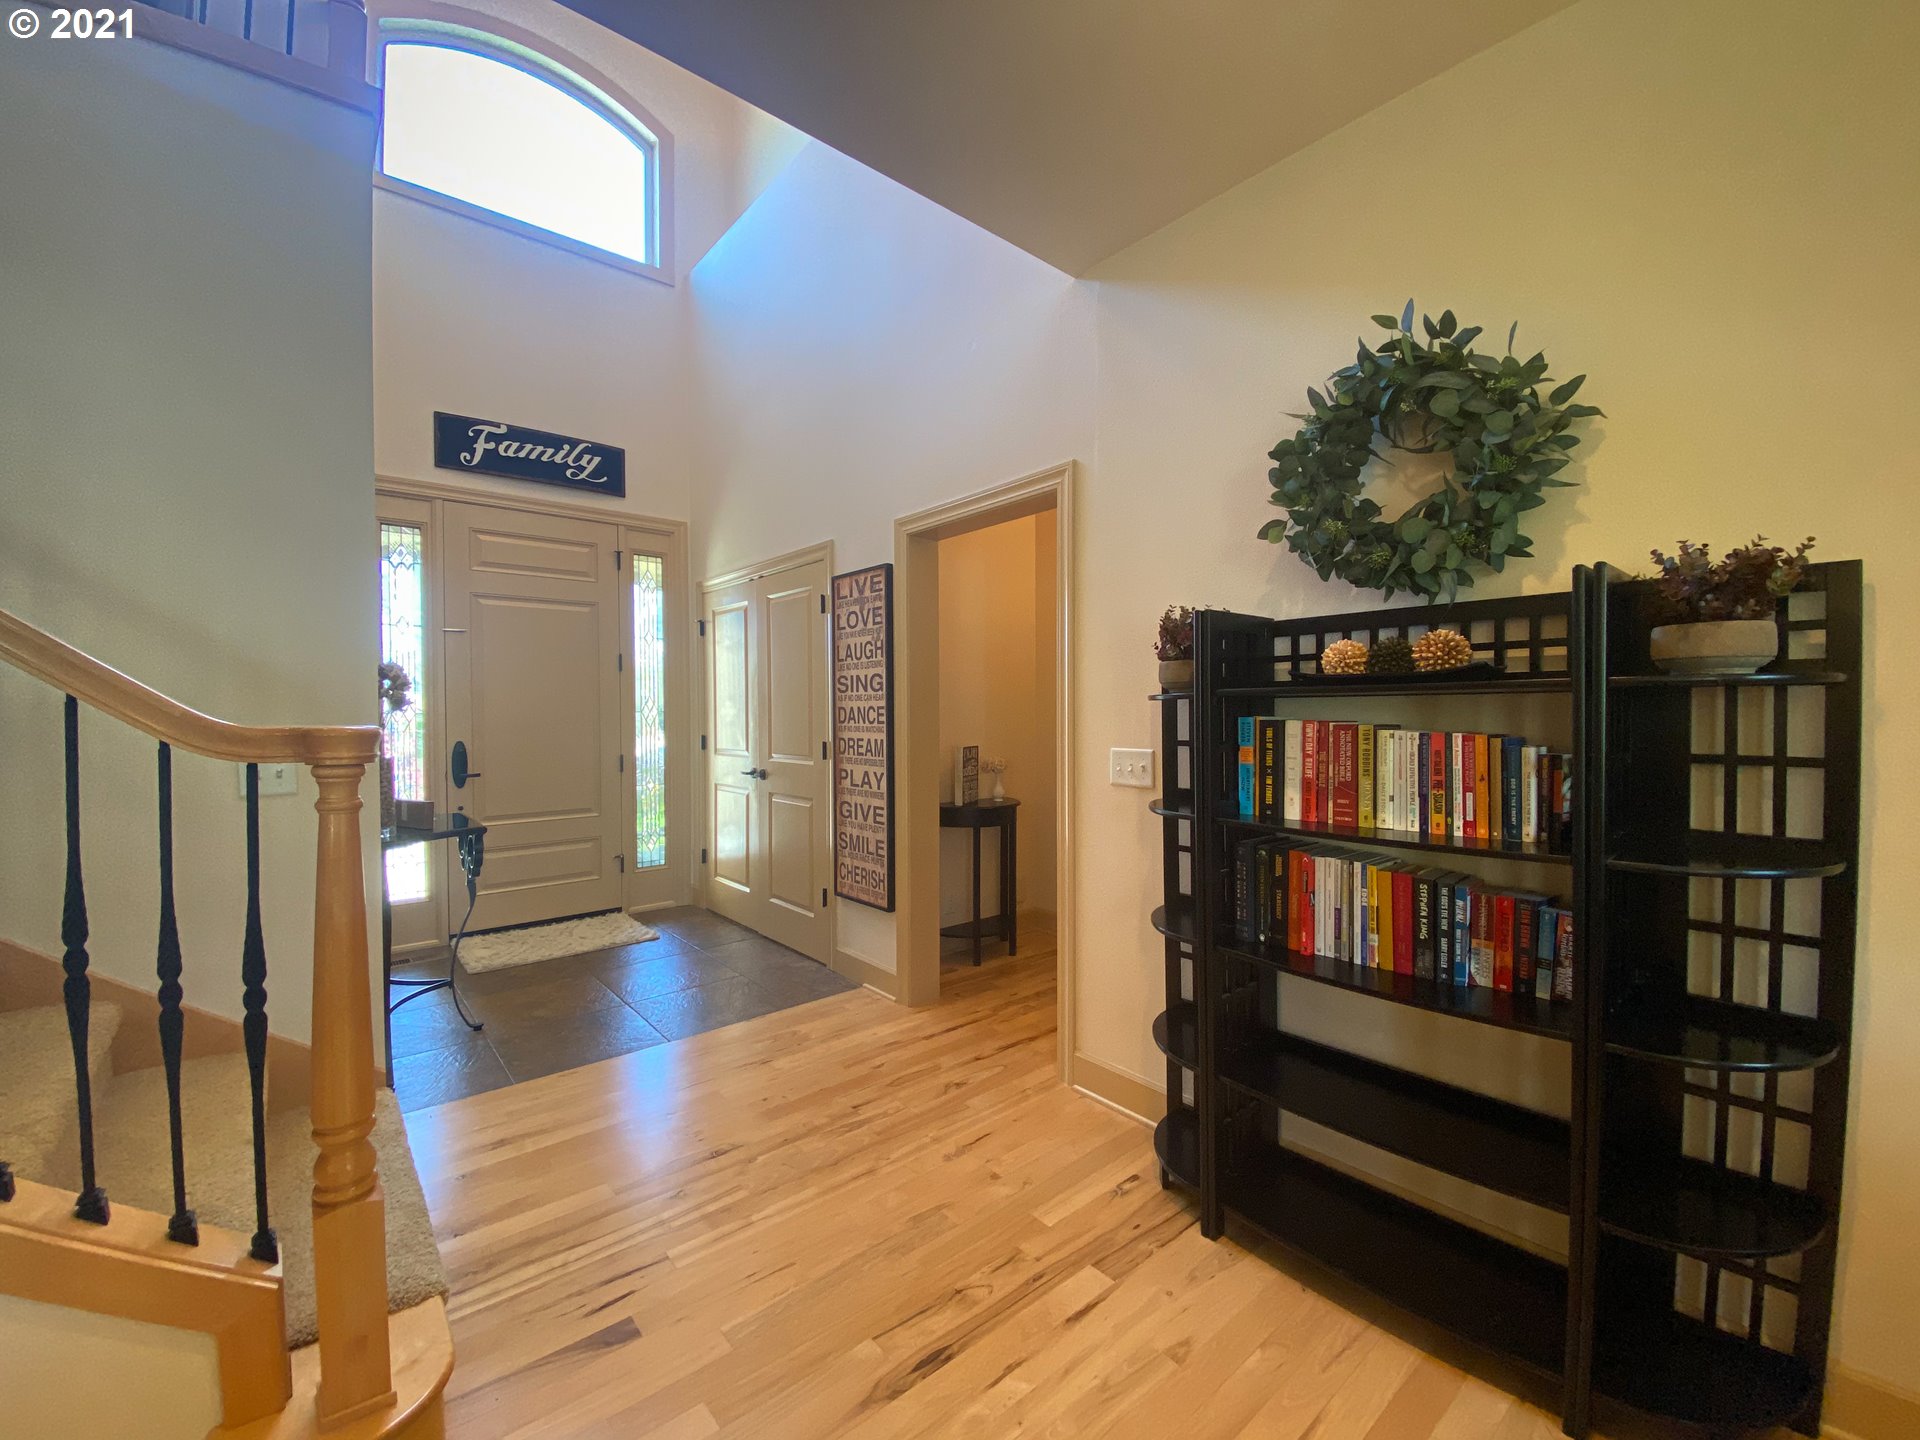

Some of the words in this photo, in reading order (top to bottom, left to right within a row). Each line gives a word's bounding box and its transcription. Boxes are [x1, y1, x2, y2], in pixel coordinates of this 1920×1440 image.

[459, 424, 608, 483] Family
[836, 574, 883, 601] LIVE
[836, 606, 883, 631] LOVE
[837, 639, 884, 663] LAUGH
[837, 673, 884, 694] SING
[838, 706, 885, 725] DANCE
[1305, 723, 1314, 737] OWN
[1362, 729, 1371, 747] TONY
[838, 737, 884, 758] DREAM
[1304, 743, 1313, 754] DAY
[1304, 766, 1313, 778] LIFE
[1362, 748, 1371, 777] ROBBINS
[839, 768, 884, 791] PLAY
[1362, 779, 1372, 812] MONEY
[840, 800, 885, 826] GIVE
[839, 832, 885, 859] SMILE
[840, 862, 886, 892] CHERISH
[1419, 883, 1428, 915] STEPHEN
[1441, 887, 1449, 895] THE
[1419, 918, 1429, 940] KING
